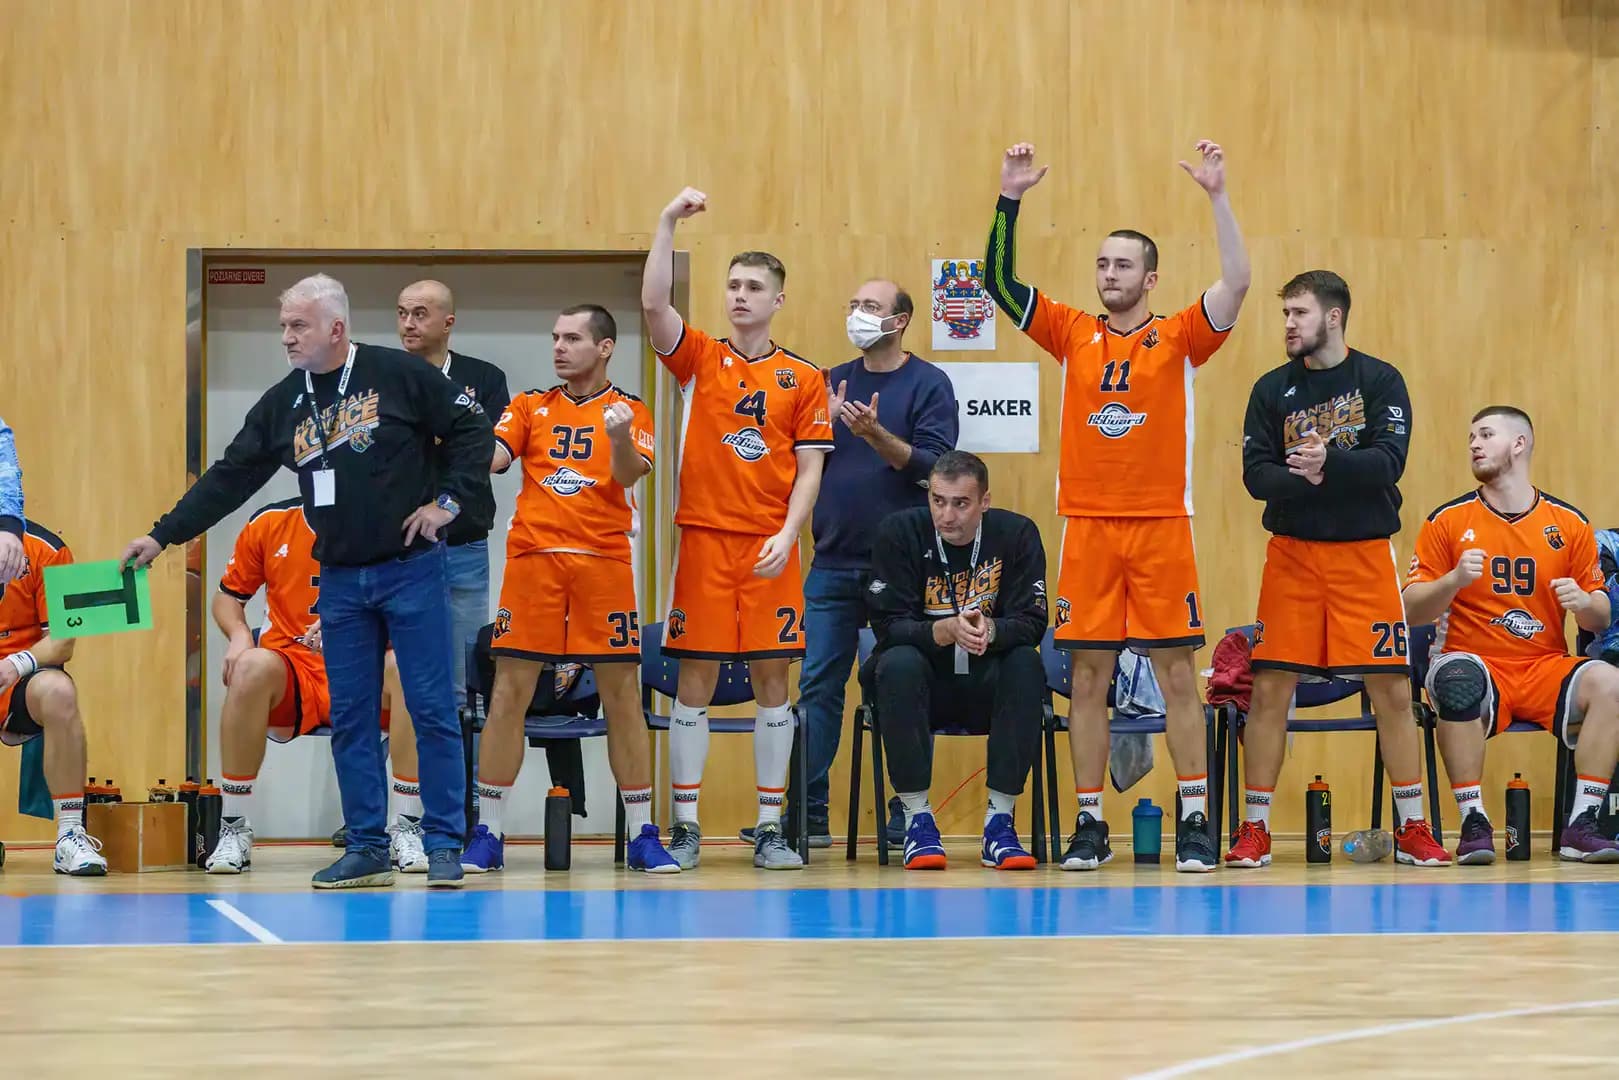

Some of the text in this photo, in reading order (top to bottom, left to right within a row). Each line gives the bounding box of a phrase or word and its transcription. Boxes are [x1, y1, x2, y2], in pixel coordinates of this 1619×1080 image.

[1099, 359, 1131, 392] 11
[966, 399, 1032, 416] SAKER
[549, 425, 595, 460] 35
[1490, 555, 1536, 597] 99
[63, 565, 140, 625] T
[1184, 591, 1203, 629] 1
[66, 616, 83, 629] 3
[607, 611, 640, 649] 35
[1371, 621, 1408, 658] 26
[675, 718, 697, 727] SELECT
[766, 719, 789, 728] SELECT
